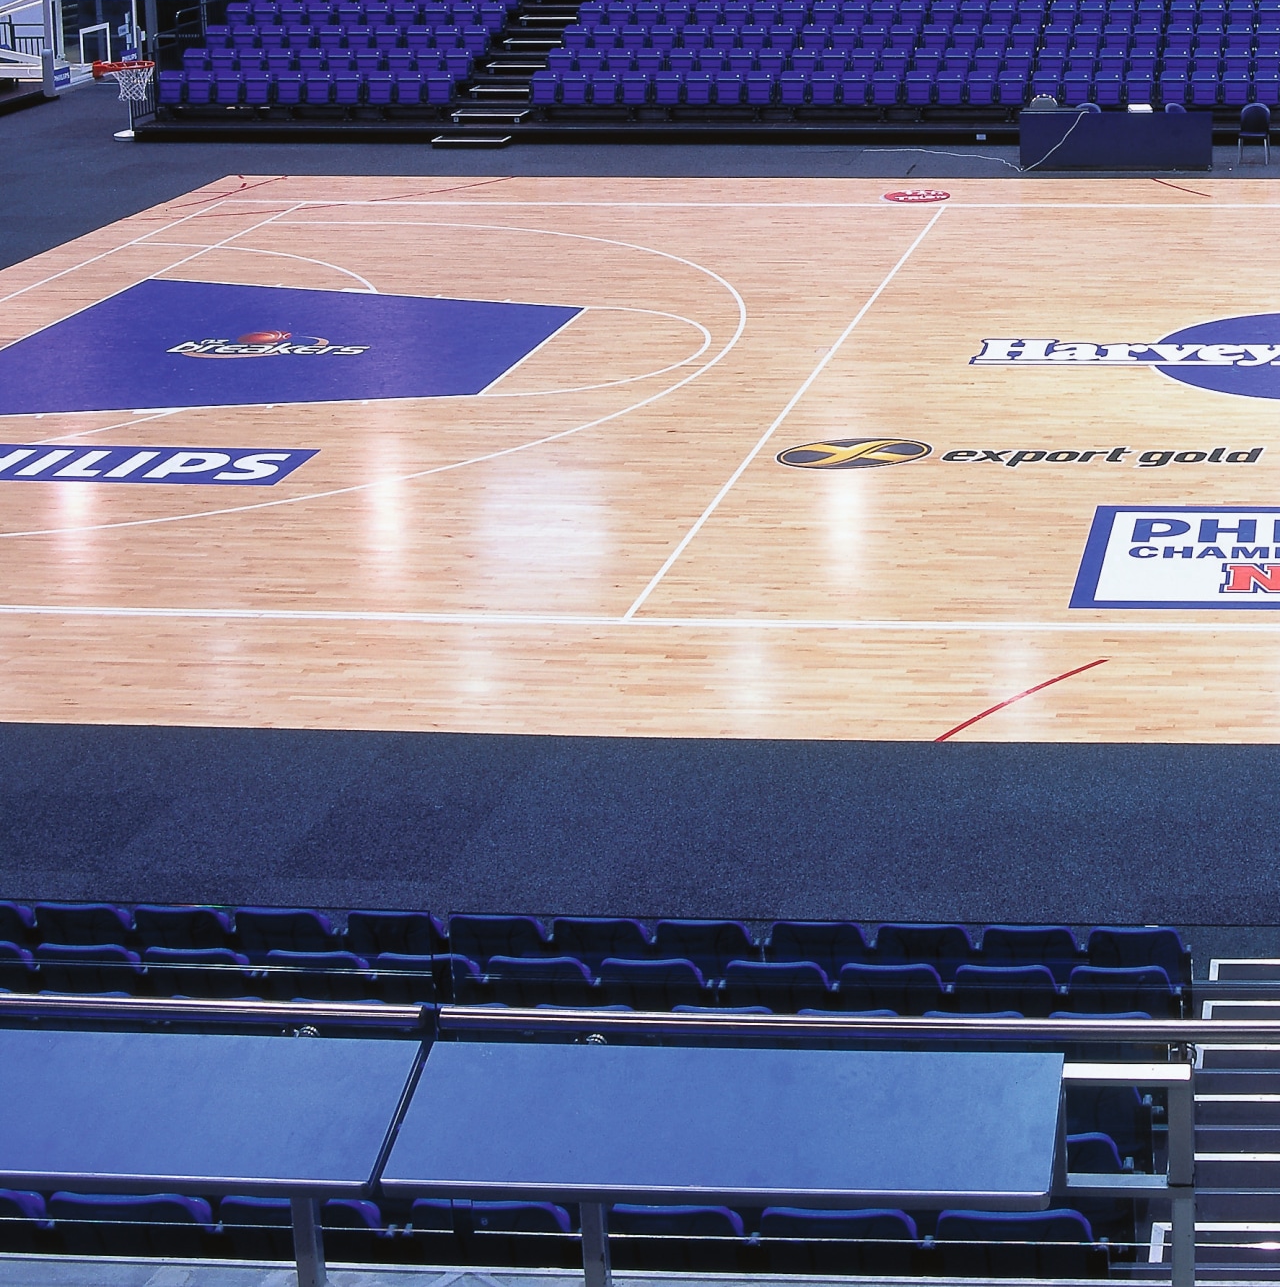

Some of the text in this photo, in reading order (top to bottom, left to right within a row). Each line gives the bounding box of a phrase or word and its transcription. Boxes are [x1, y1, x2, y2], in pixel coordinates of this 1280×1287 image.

[166, 341, 371, 357] breakers
[941, 445, 1266, 469] export gold
